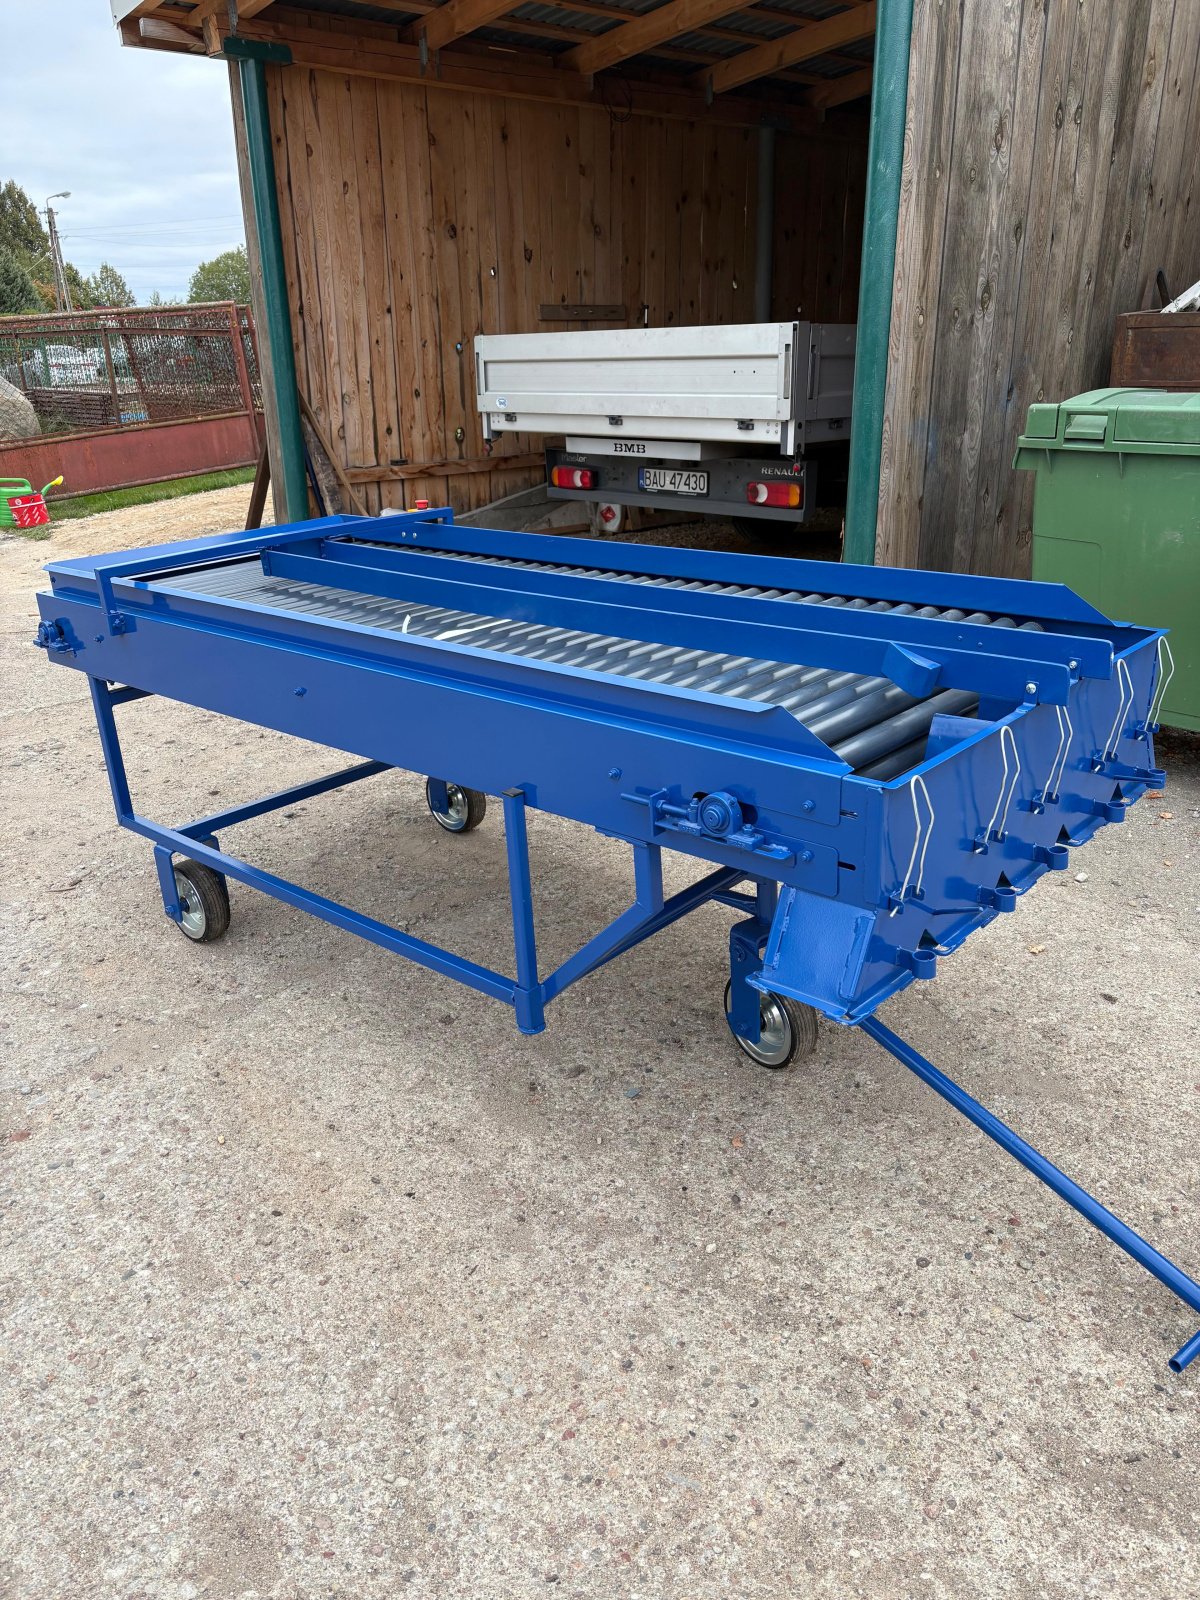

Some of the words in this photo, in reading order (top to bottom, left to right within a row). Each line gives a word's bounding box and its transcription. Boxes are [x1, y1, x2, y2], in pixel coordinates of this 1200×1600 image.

[613, 442, 646, 454] BMB
[645, 470, 666, 488] BAU
[670, 472, 706, 491] 47430
